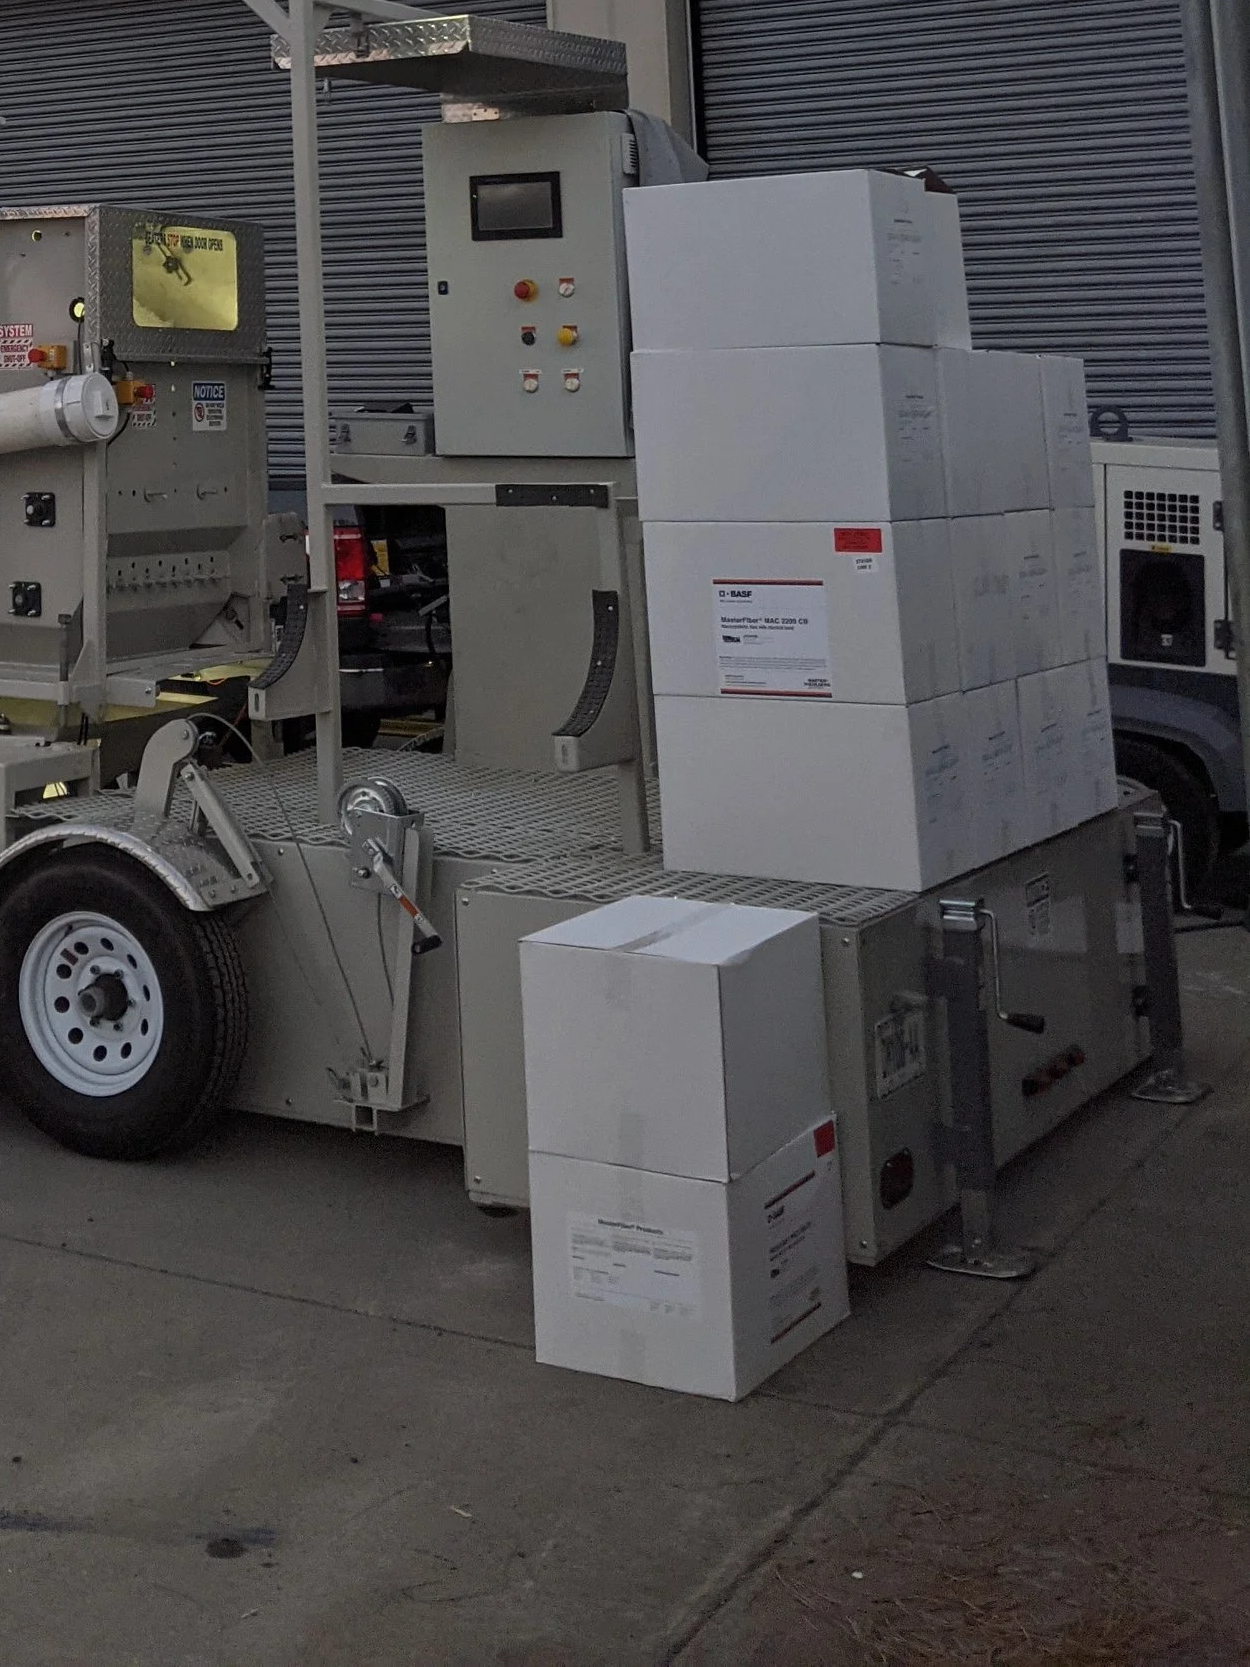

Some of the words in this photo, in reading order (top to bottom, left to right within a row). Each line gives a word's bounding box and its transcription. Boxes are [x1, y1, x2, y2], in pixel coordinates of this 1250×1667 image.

[194, 236, 207, 250] DOOR
[194, 385, 224, 399] NOTICE
[730, 590, 752, 598] BASF
